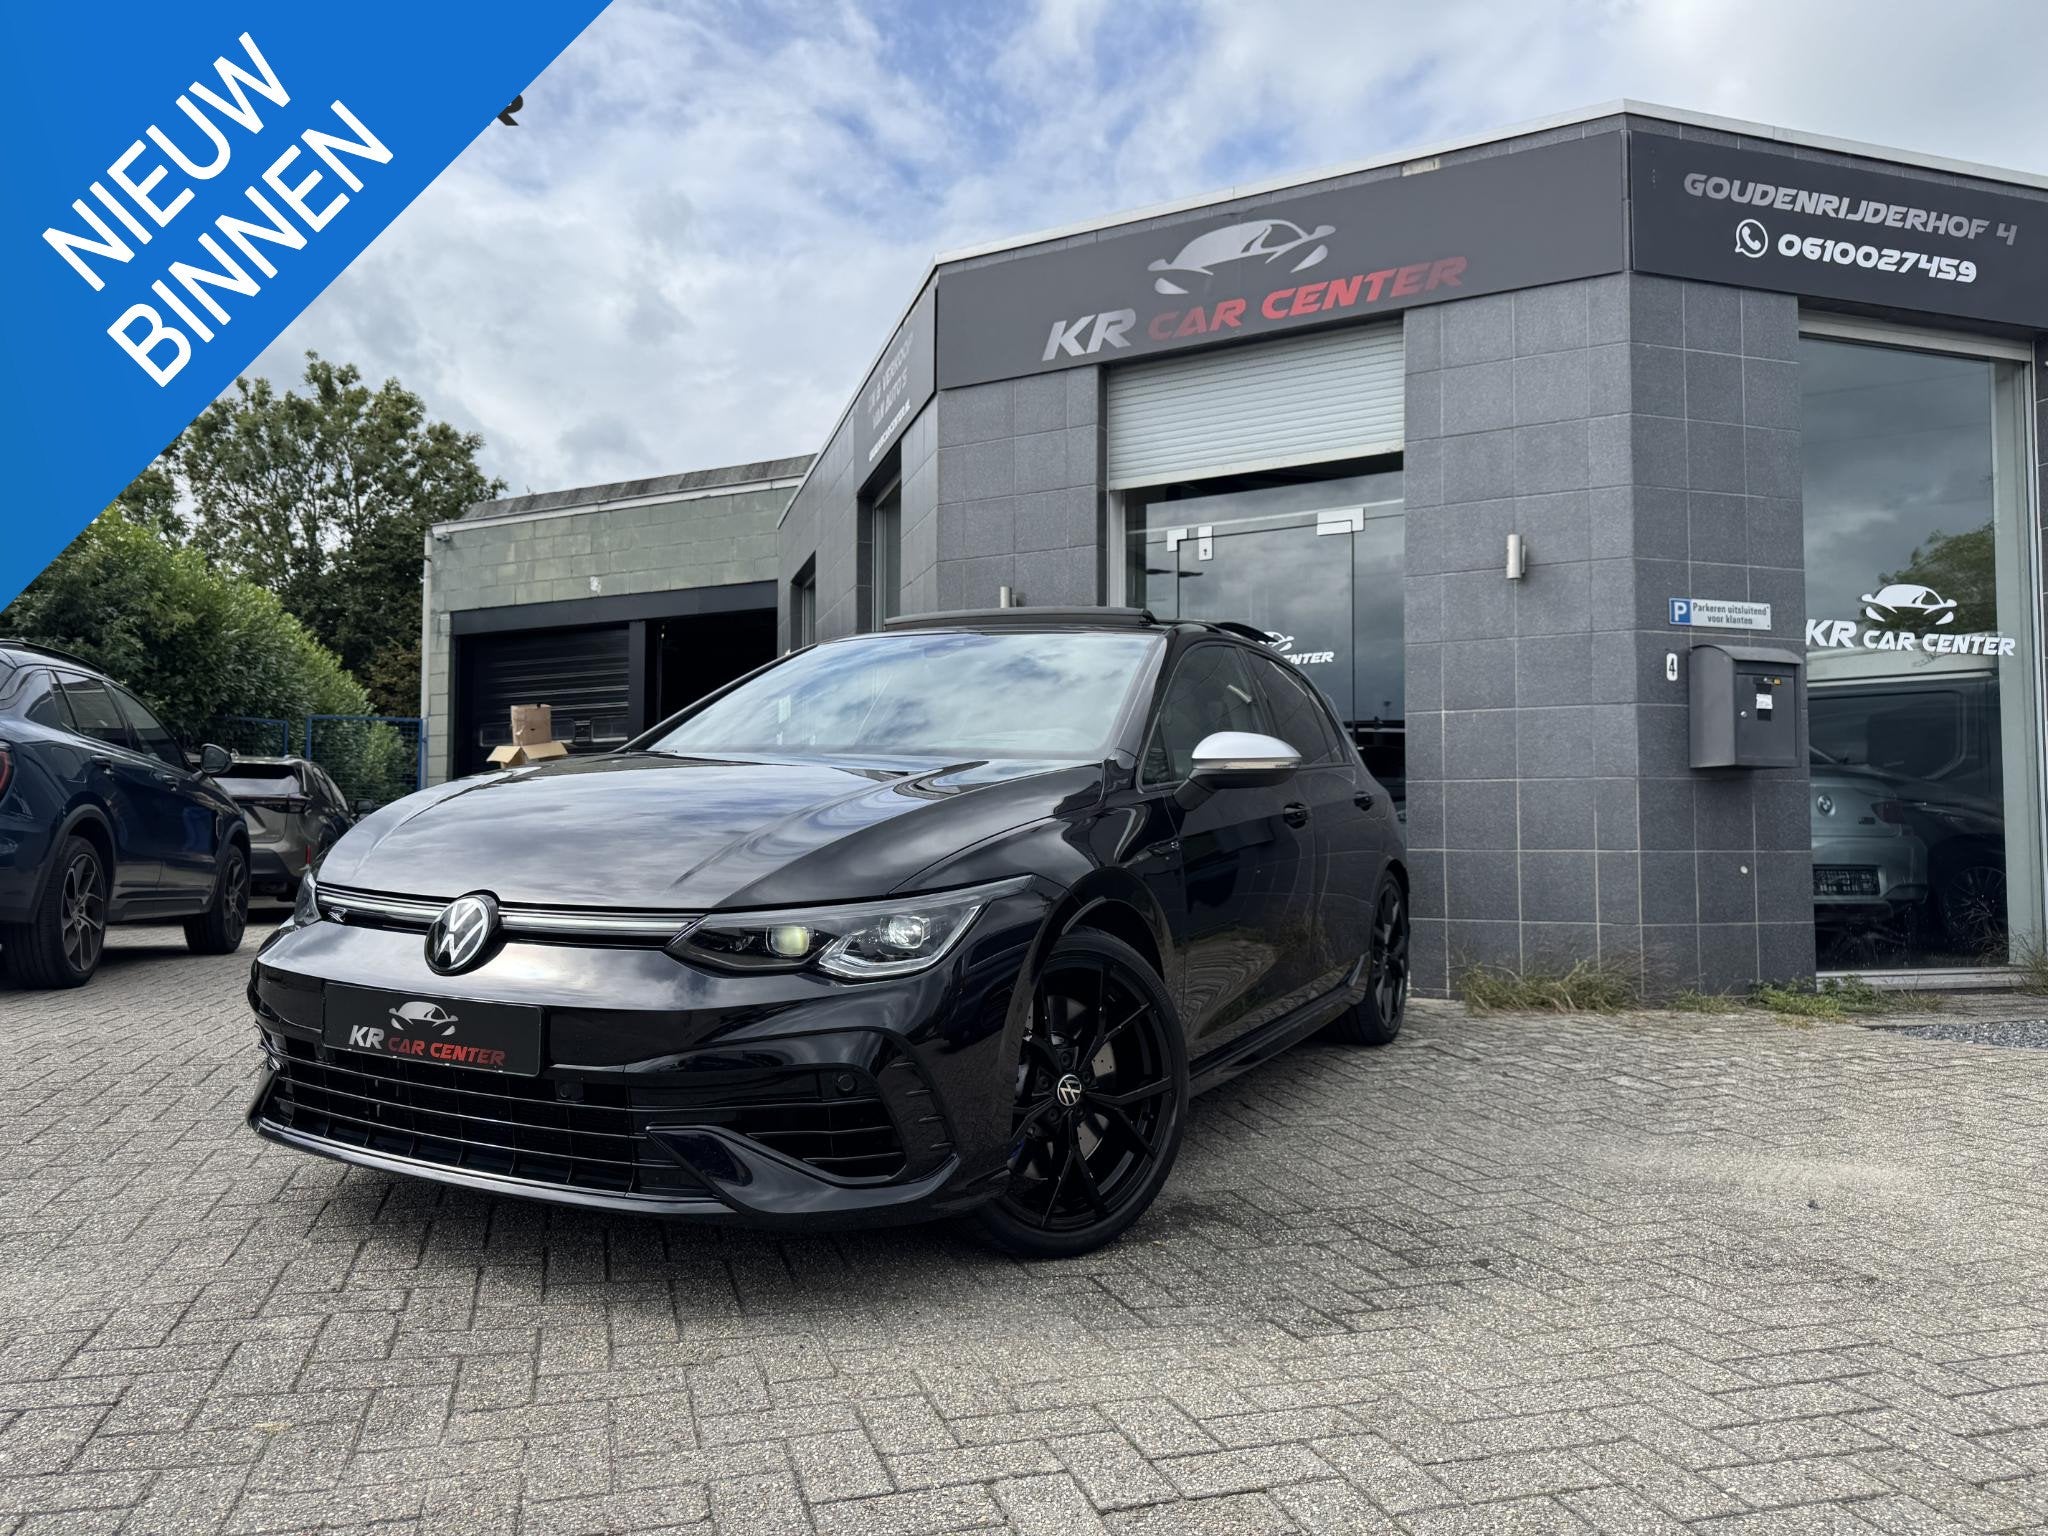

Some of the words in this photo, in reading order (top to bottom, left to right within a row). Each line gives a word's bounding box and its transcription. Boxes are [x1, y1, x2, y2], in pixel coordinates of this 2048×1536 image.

[1684, 173, 1991, 240] GOUDENRIJDERHOF
[1996, 224, 2018, 246] 4
[1778, 233, 1977, 284] 0610027459
[1042, 308, 1136, 361] KR
[1148, 298, 1246, 341] CAR
[1261, 256, 1468, 320] CENTER
[1693, 602, 1726, 614] Parkeren
[1728, 604, 1767, 616] uitsluitend
[1726, 615, 1753, 625] klanten
[1805, 619, 1857, 649] KR
[1863, 630, 1915, 651] CAR
[1922, 633, 2016, 656] CENTER
[1668, 657, 1676, 677] 4
[349, 1025, 385, 1049] KR
[388, 1037, 426, 1056] CAR
[430, 1042, 506, 1066] CENTER
